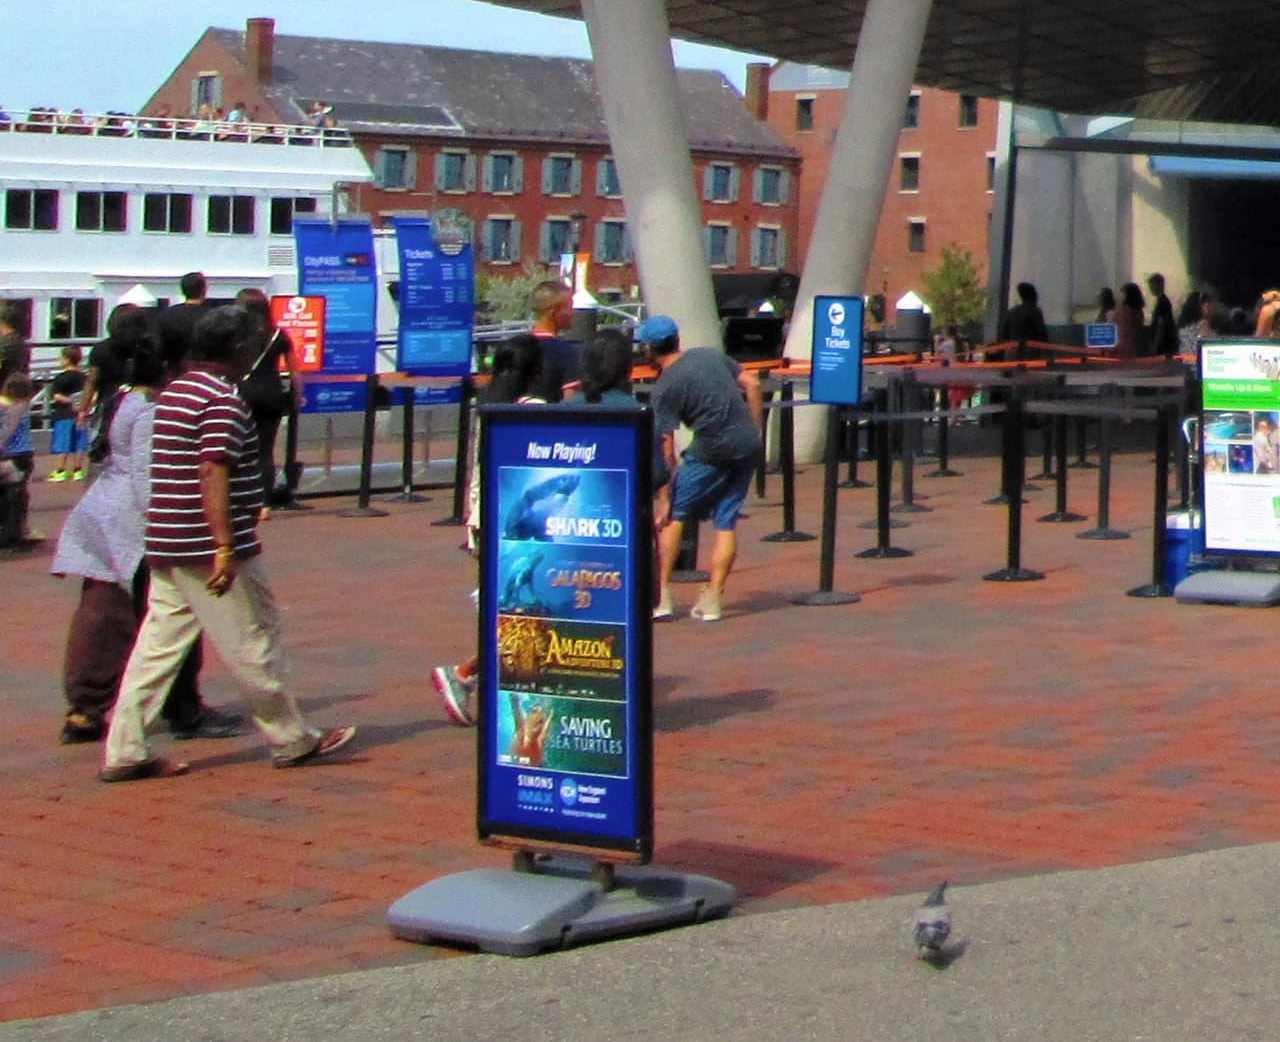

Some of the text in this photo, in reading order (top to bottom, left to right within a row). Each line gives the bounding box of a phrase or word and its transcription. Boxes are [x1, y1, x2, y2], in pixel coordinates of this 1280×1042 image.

[404, 249, 434, 260] Tickets
[831, 325, 846, 339] Buy
[825, 337, 851, 349] Tickets
[526, 442, 598, 464] Now Playing!
[545, 517, 623, 538] SHARK 3D
[547, 568, 622, 591] GALAPAGOS
[575, 589, 593, 610] 3D
[546, 630, 612, 665] AMAZON
[559, 716, 612, 739] SAVING
[550, 735, 624, 756] SEA TURTLES
[517, 774, 554, 790] SIMONS
